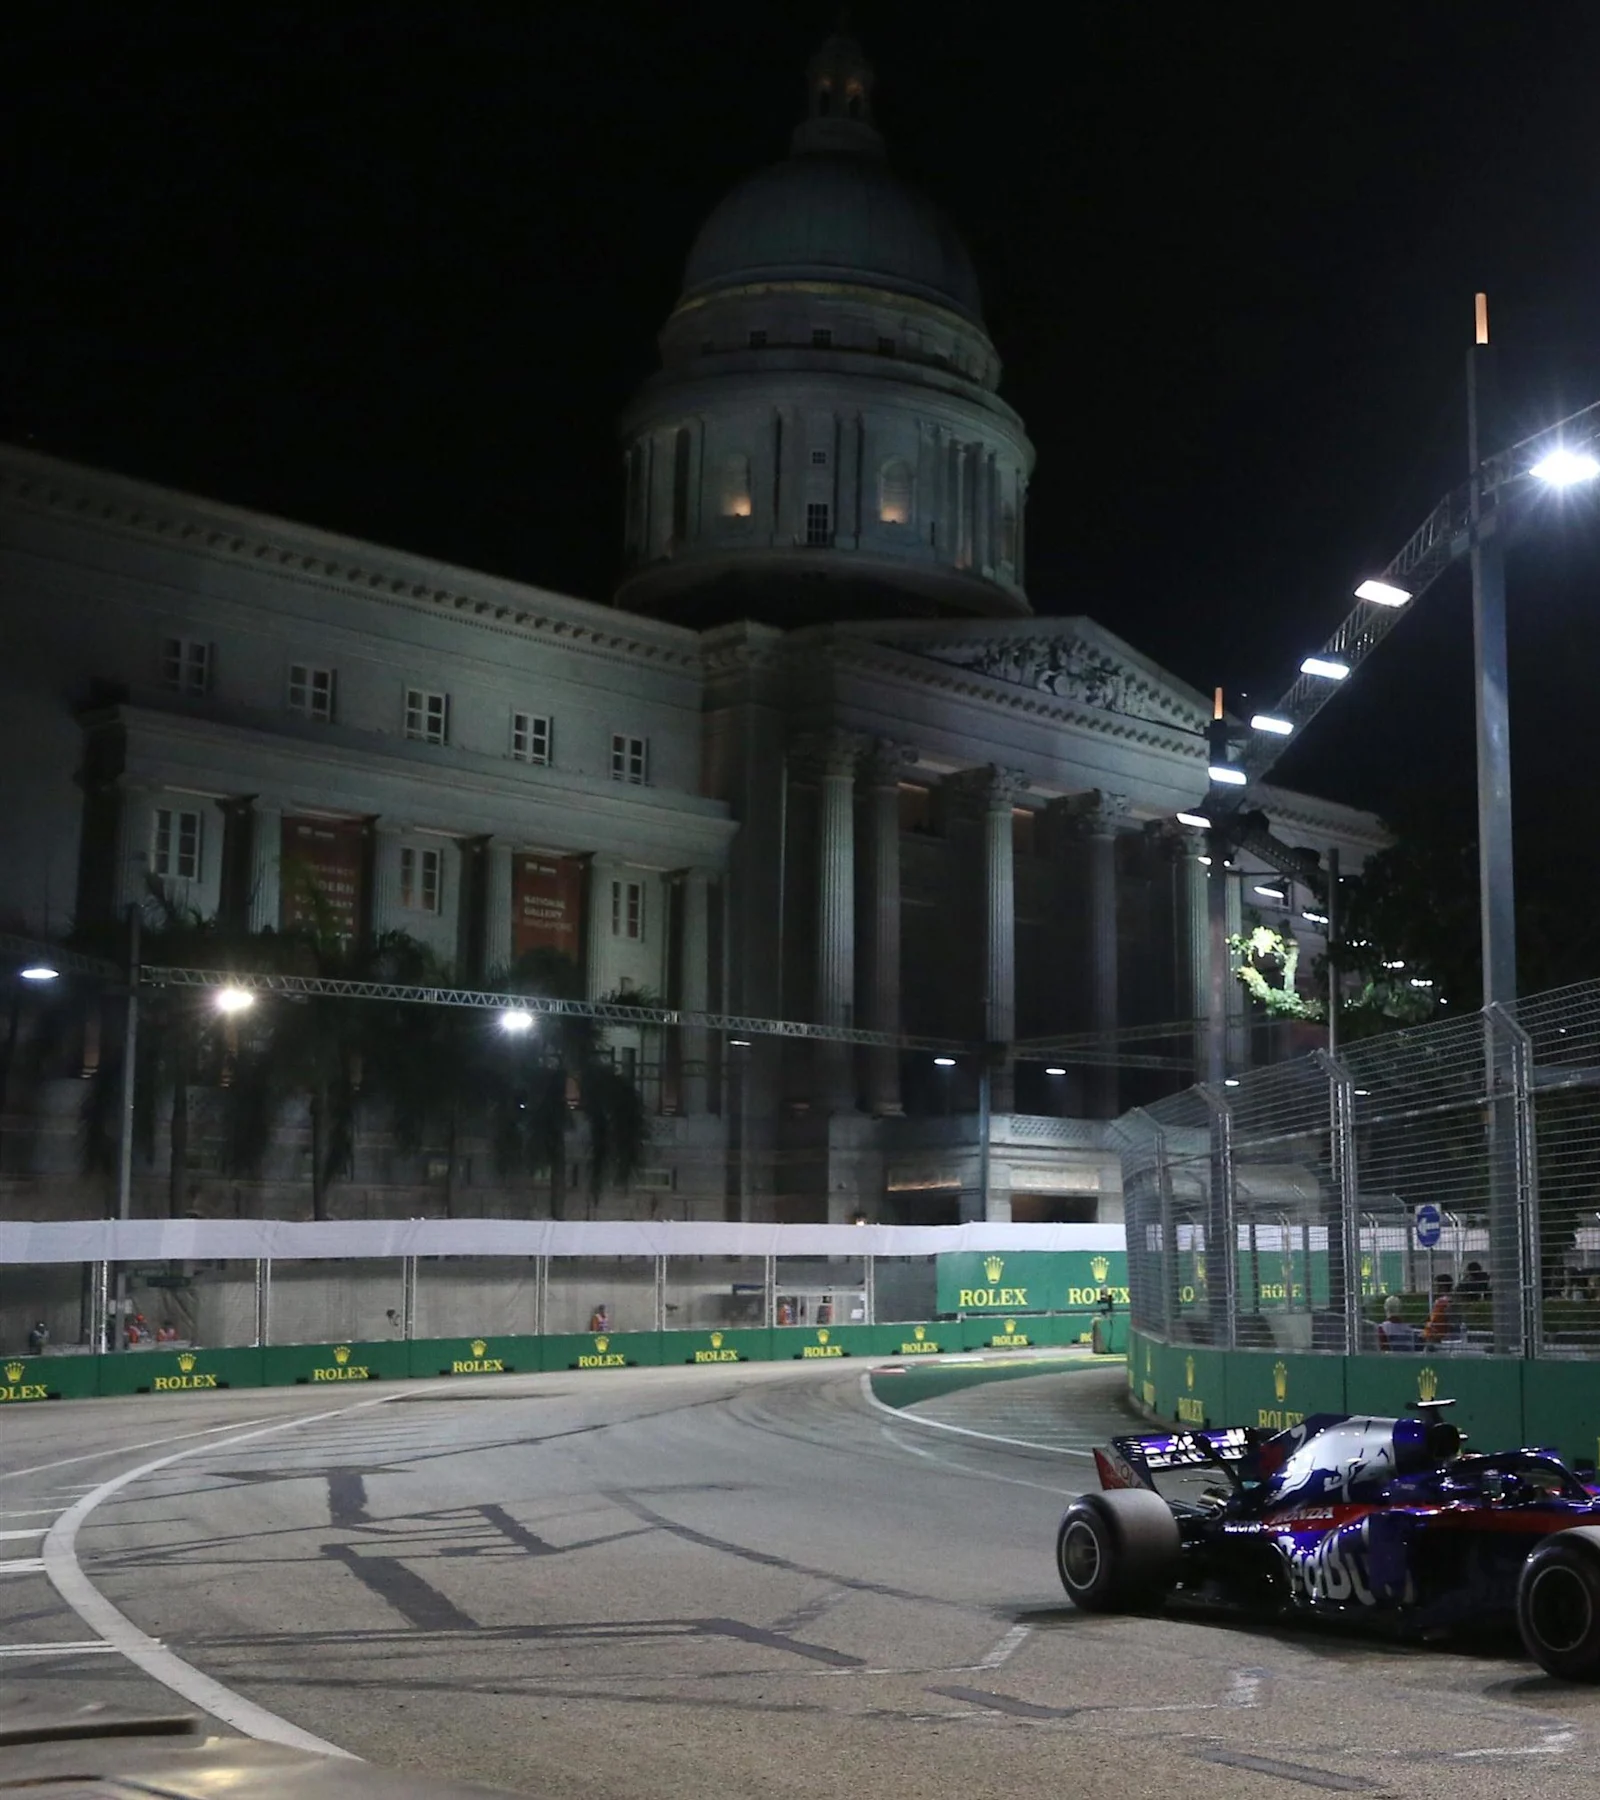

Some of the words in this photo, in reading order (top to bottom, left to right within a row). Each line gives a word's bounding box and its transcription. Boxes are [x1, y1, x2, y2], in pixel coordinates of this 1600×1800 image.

[959, 1288, 1028, 1306] ROLEX
[992, 1334, 1028, 1346] ROLEX
[803, 1345, 843, 1357] ROLEX
[901, 1343, 938, 1354] ROLEX
[578, 1355, 625, 1367] ROLEX
[695, 1350, 737, 1362] ROLEX
[452, 1359, 504, 1373] ROLEX
[313, 1366, 370, 1381] ROLEX
[154, 1374, 217, 1389] ROLEX
